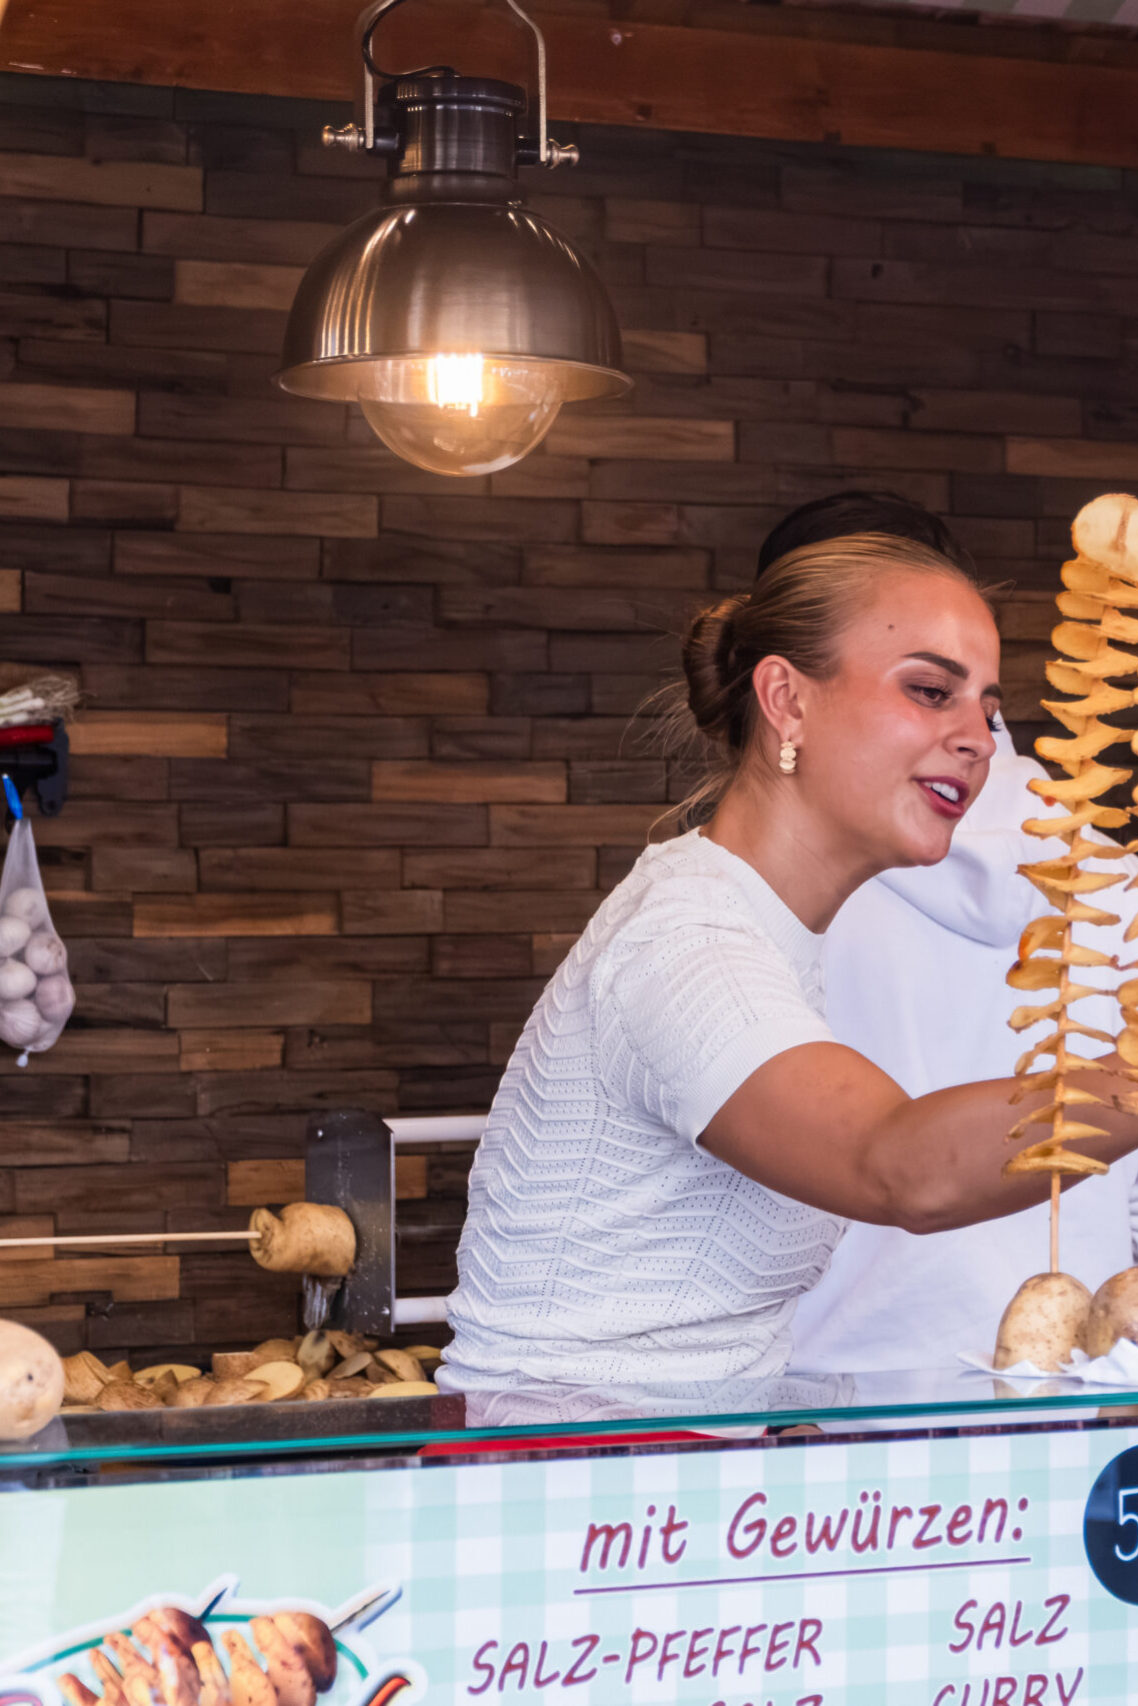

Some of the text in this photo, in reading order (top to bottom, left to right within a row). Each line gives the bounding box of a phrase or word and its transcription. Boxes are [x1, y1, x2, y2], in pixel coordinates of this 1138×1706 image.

[579, 1490, 1031, 1573] mit Gewürzen:
[466, 1617, 825, 1696] SALZ-PFEFFER
[948, 1593, 1072, 1654] SALZ
